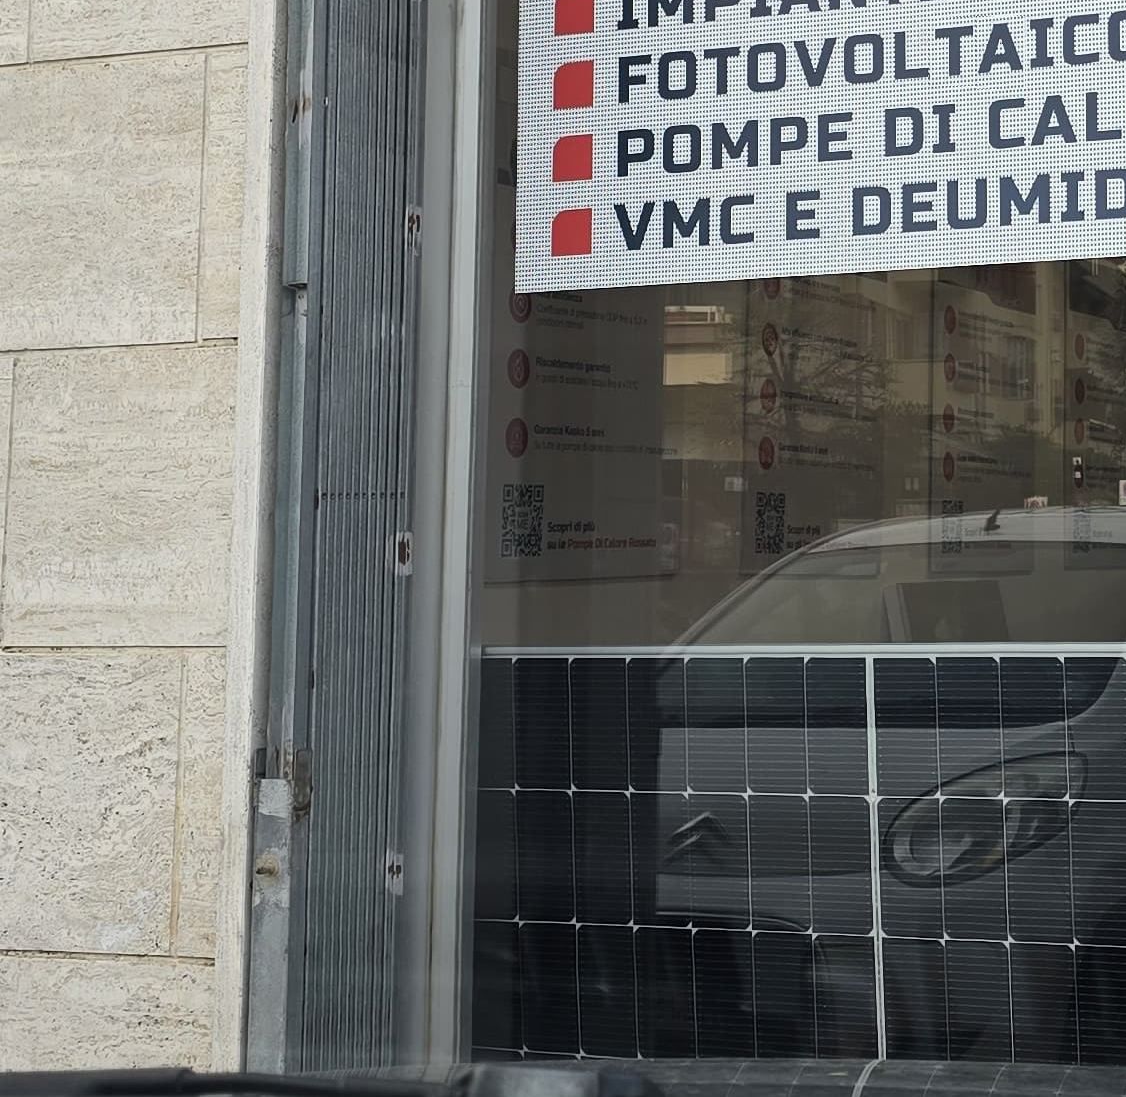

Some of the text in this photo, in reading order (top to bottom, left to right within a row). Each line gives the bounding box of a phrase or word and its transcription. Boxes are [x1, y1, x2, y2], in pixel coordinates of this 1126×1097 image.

[617, 111, 854, 177] POMPE
[884, 104, 957, 157] DI
[613, 195, 754, 251] VMC
[785, 190, 820, 241] E
